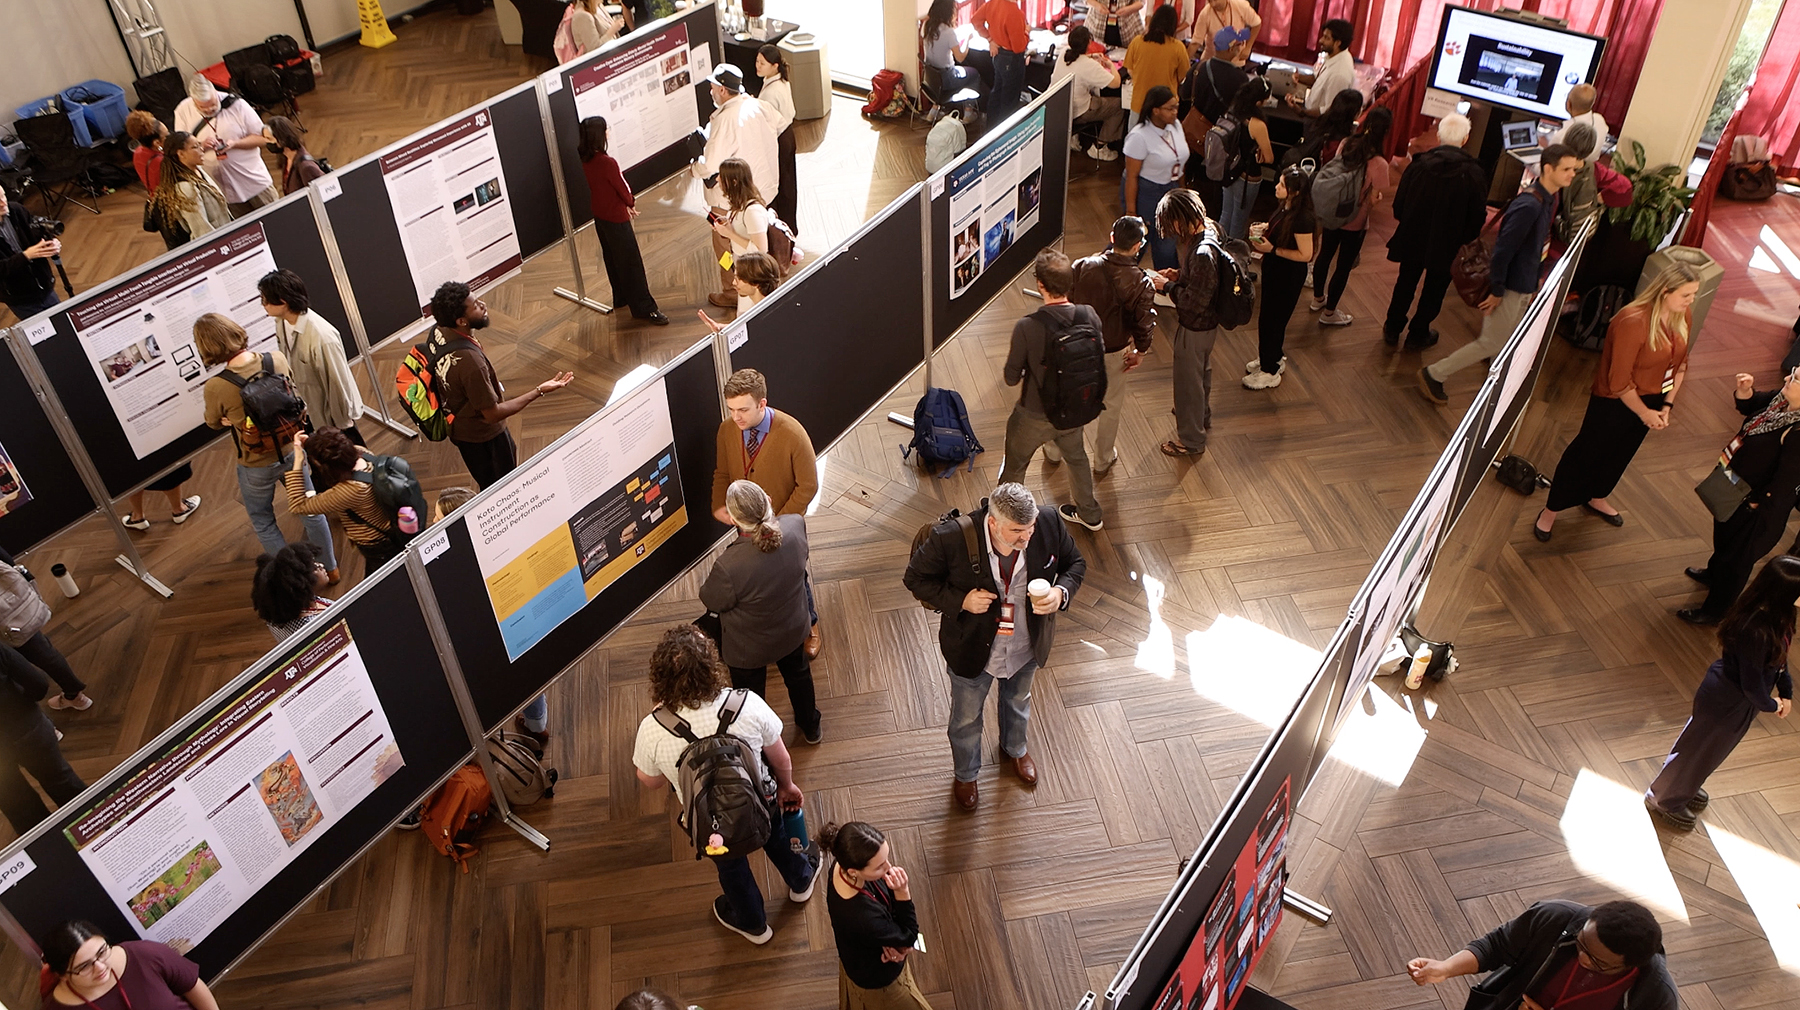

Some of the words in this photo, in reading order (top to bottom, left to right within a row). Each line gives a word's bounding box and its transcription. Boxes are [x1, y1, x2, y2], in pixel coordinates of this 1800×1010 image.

[1497, 42, 1533, 57] Sustainability
[77, 304, 96, 317] Touching
[182, 257, 196, 267] Virtual
[196, 248, 216, 260] Production
[31, 326, 45, 338] P07
[730, 330, 744, 345] GP07
[477, 505, 495, 520] Koto
[496, 487, 521, 507] Chaos:
[523, 467, 549, 489] Musical
[480, 498, 519, 529] Instrument
[482, 501, 528, 537] Construction
[531, 495, 539, 503] as
[485, 525, 508, 545] Global
[510, 492, 555, 527] Performance
[424, 537, 445, 555] GP08
[82, 810, 114, 836] Archetypes
[114, 801, 126, 812] with
[126, 774, 162, 803] Southwestern
[163, 753, 191, 776] Landscape
[191, 745, 201, 754] and
[201, 733, 216, 746] Texas
[216, 724, 228, 735] Lore
[234, 708, 249, 721] Visual
[248, 688, 276, 711] Storytelling
[115, 794, 125, 804] the
[125, 777, 148, 797] Western
[148, 760, 171, 780] Narrative
[172, 744, 192, 762] through
[192, 724, 220, 747] Mythology:
[220, 704, 246, 726] Integrating
[246, 690, 264, 706] Eastern
